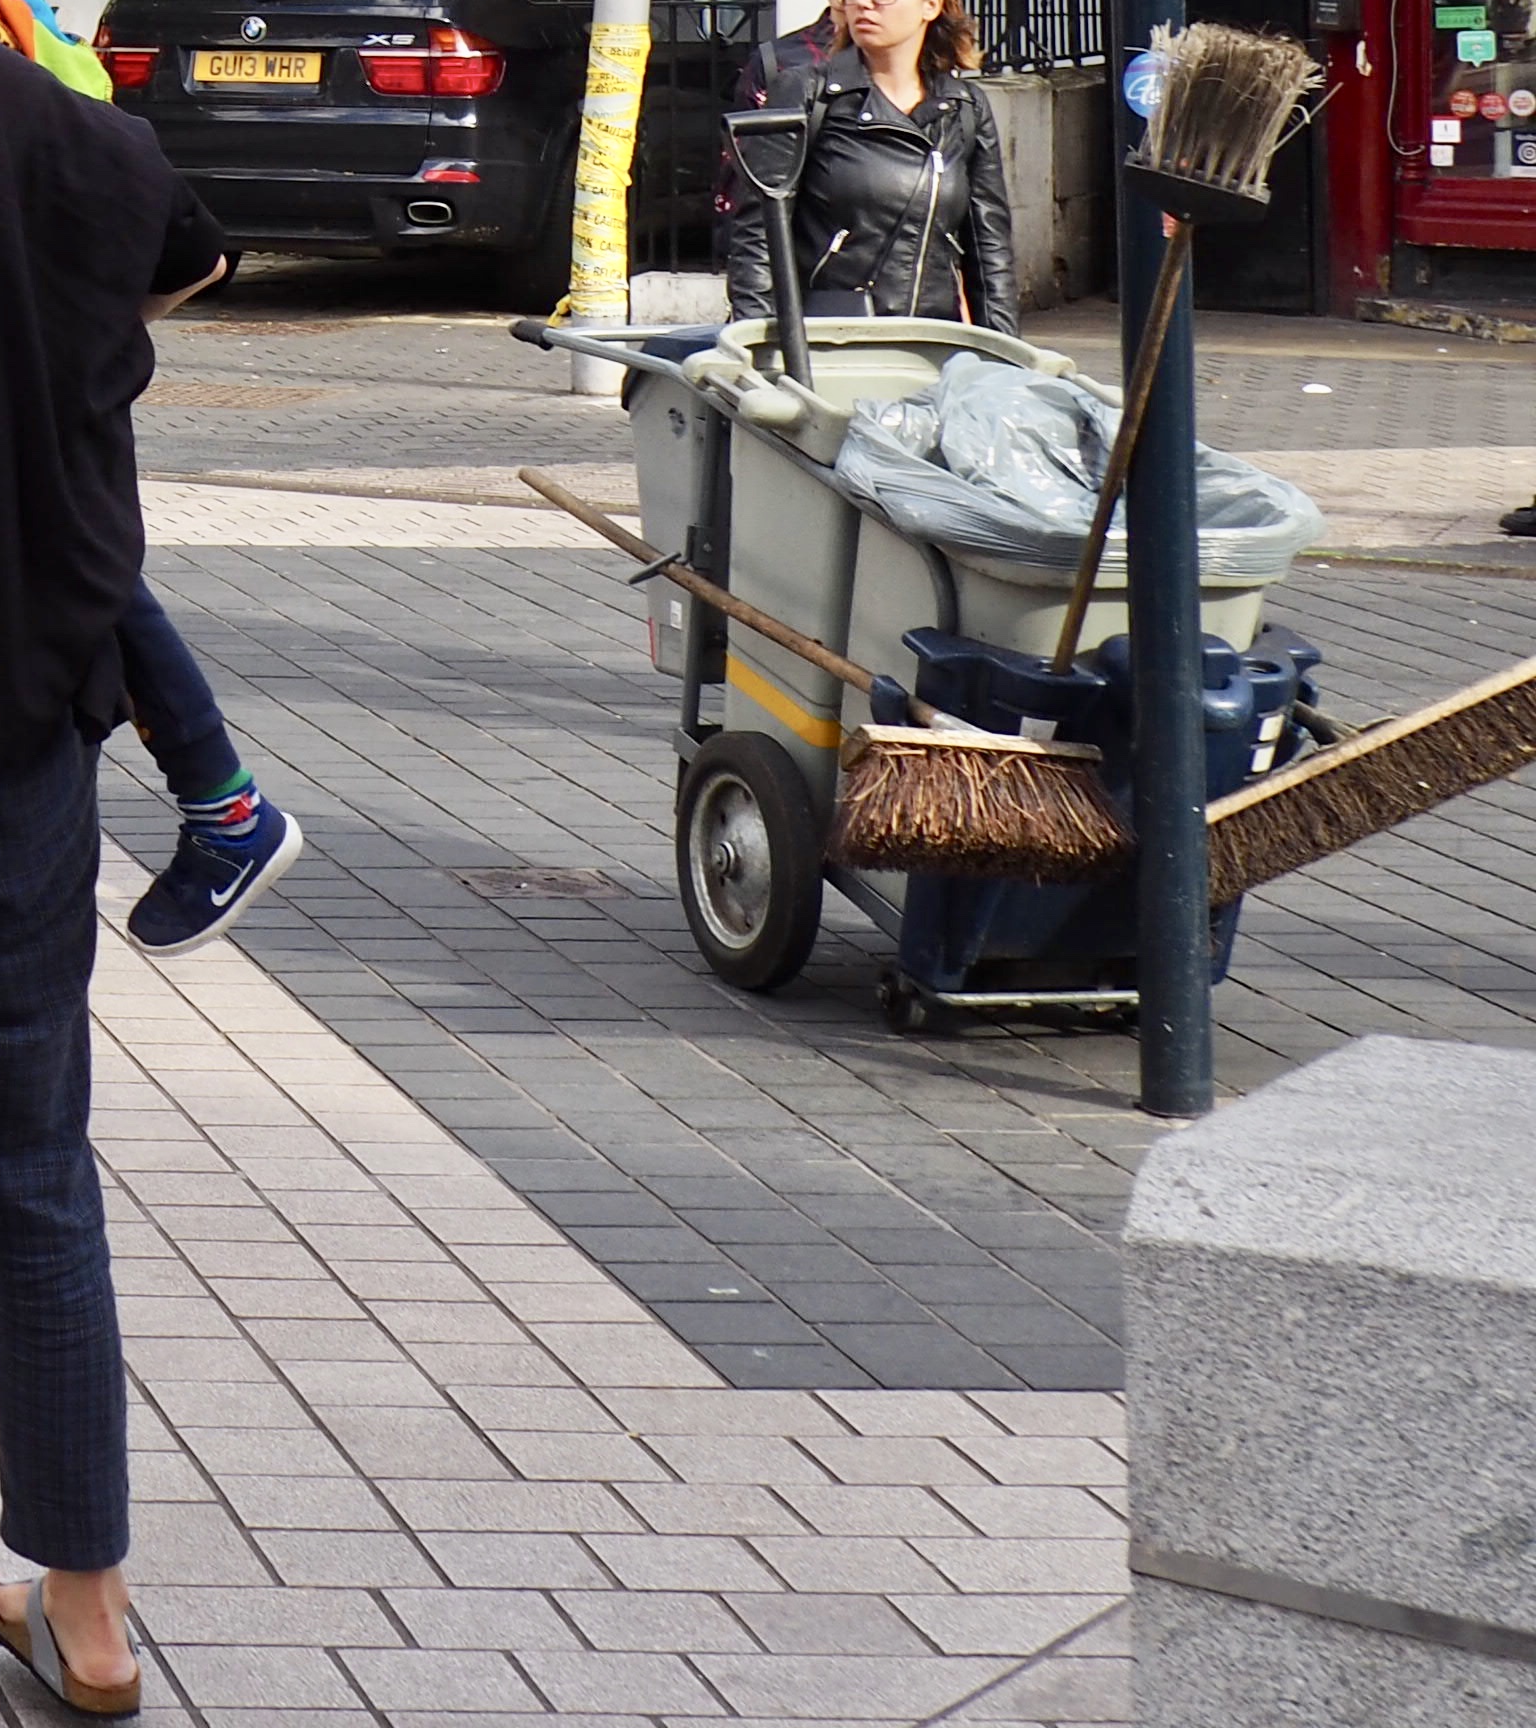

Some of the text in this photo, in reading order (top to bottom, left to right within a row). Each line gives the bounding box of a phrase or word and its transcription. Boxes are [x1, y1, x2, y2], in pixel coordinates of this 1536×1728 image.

[363, 34, 416, 46] X5
[210, 56, 306, 78] GU13 WHR
